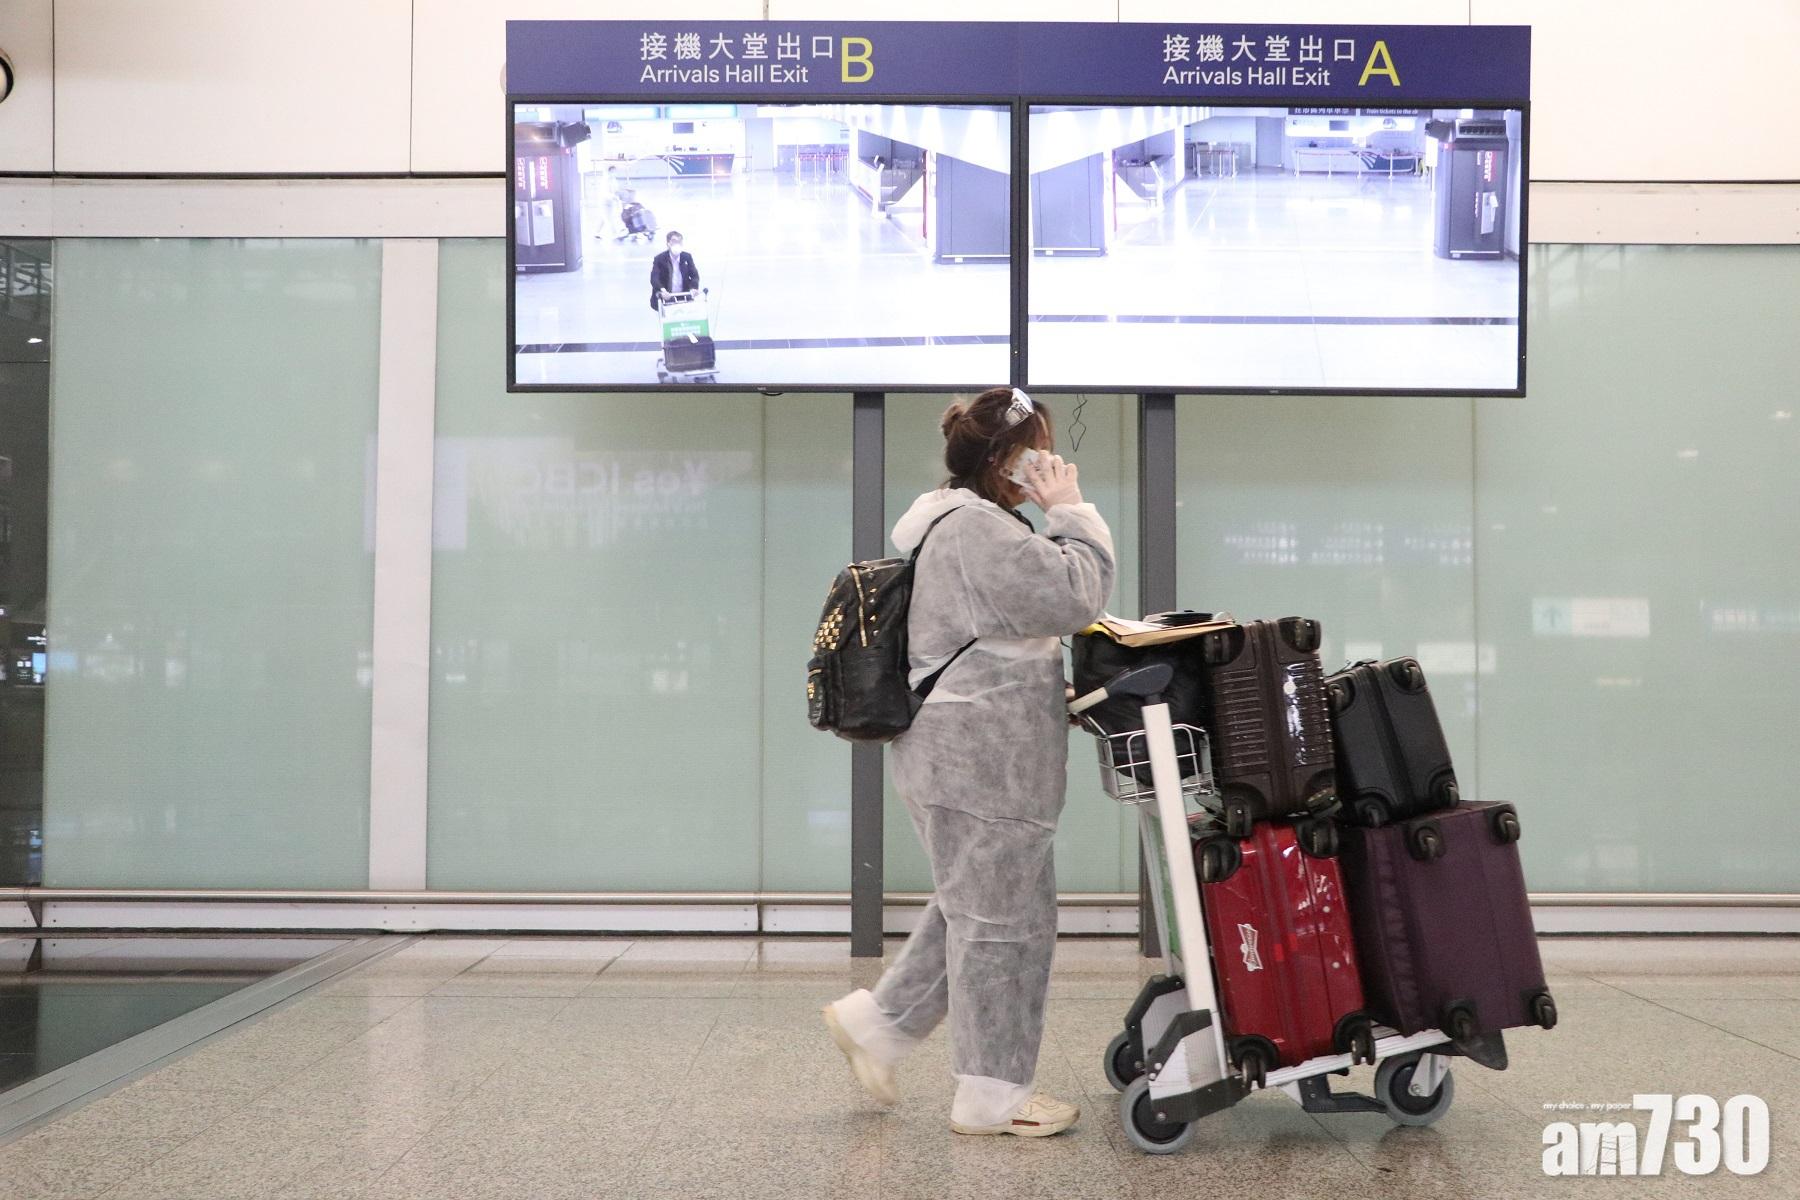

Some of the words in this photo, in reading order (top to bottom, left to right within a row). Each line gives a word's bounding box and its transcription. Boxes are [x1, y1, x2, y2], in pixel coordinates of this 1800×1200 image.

[640, 32, 833, 60] 接機大堂出口
[841, 37, 875, 83] B
[1163, 34, 1355, 63] 接機大堂出口
[640, 64, 720, 83] Arrivals
[726, 65, 764, 83] Hall
[770, 65, 809, 83] Exit
[1163, 66, 1242, 85] Arrivals
[1248, 67, 1286, 85] Hall
[1292, 68, 1331, 86] Exit
[1358, 40, 1401, 86] A
